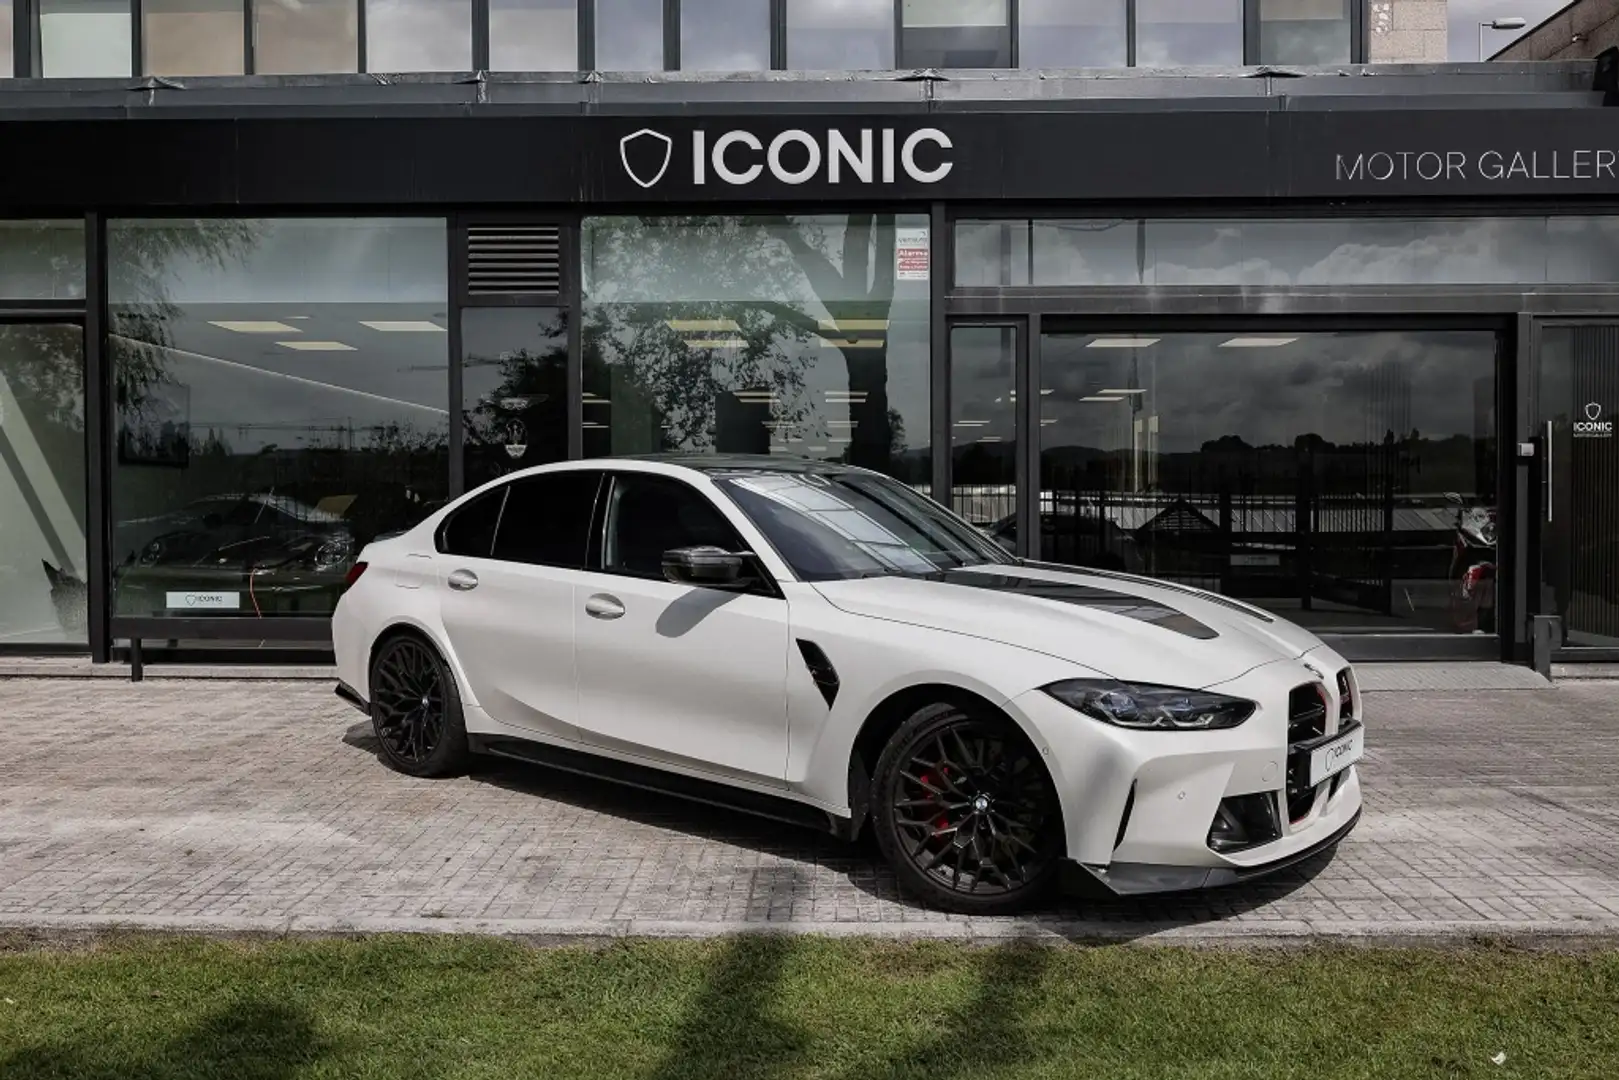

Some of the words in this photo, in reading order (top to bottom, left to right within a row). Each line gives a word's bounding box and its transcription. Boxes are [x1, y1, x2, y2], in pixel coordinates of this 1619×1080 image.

[692, 128, 954, 184] ICONIC
[1335, 151, 1467, 180] MOTOR
[1478, 150, 1619, 180] GALLER
[1573, 422, 1612, 431] ICONIC
